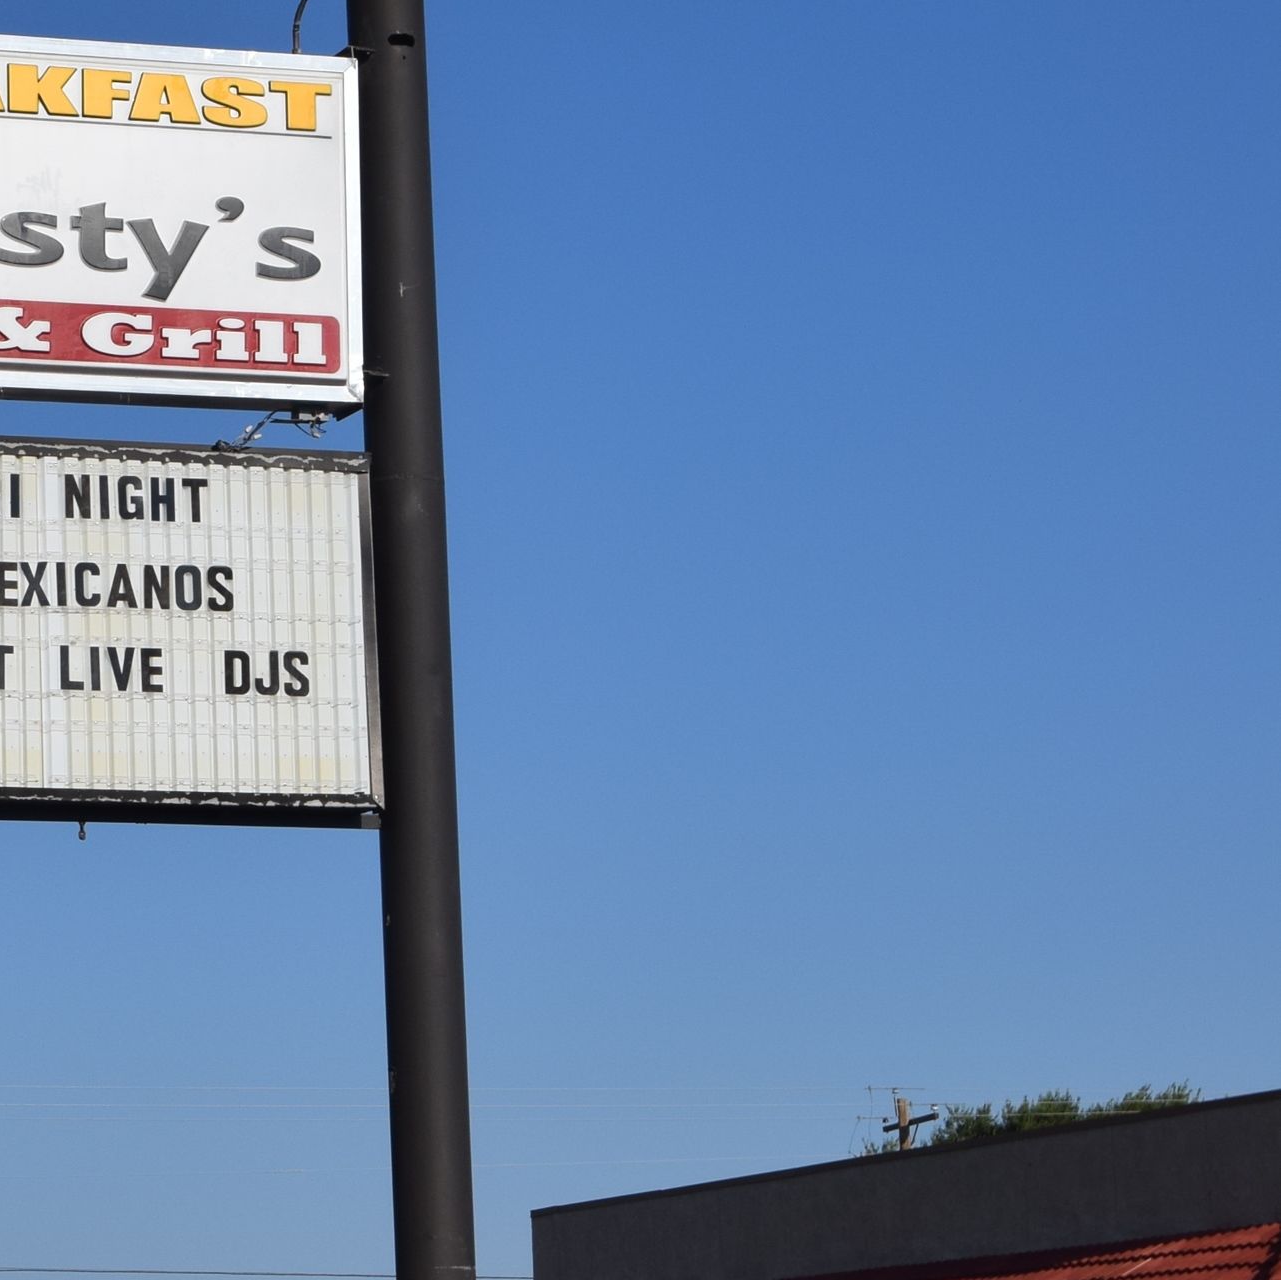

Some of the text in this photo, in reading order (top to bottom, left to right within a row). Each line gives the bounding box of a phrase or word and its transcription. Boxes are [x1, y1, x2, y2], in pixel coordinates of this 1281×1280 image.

[82, 312, 327, 366] Grill
[64, 474, 208, 523] NIGHT
[60, 645, 164, 693] LIVE
[224, 650, 310, 697] DJS
